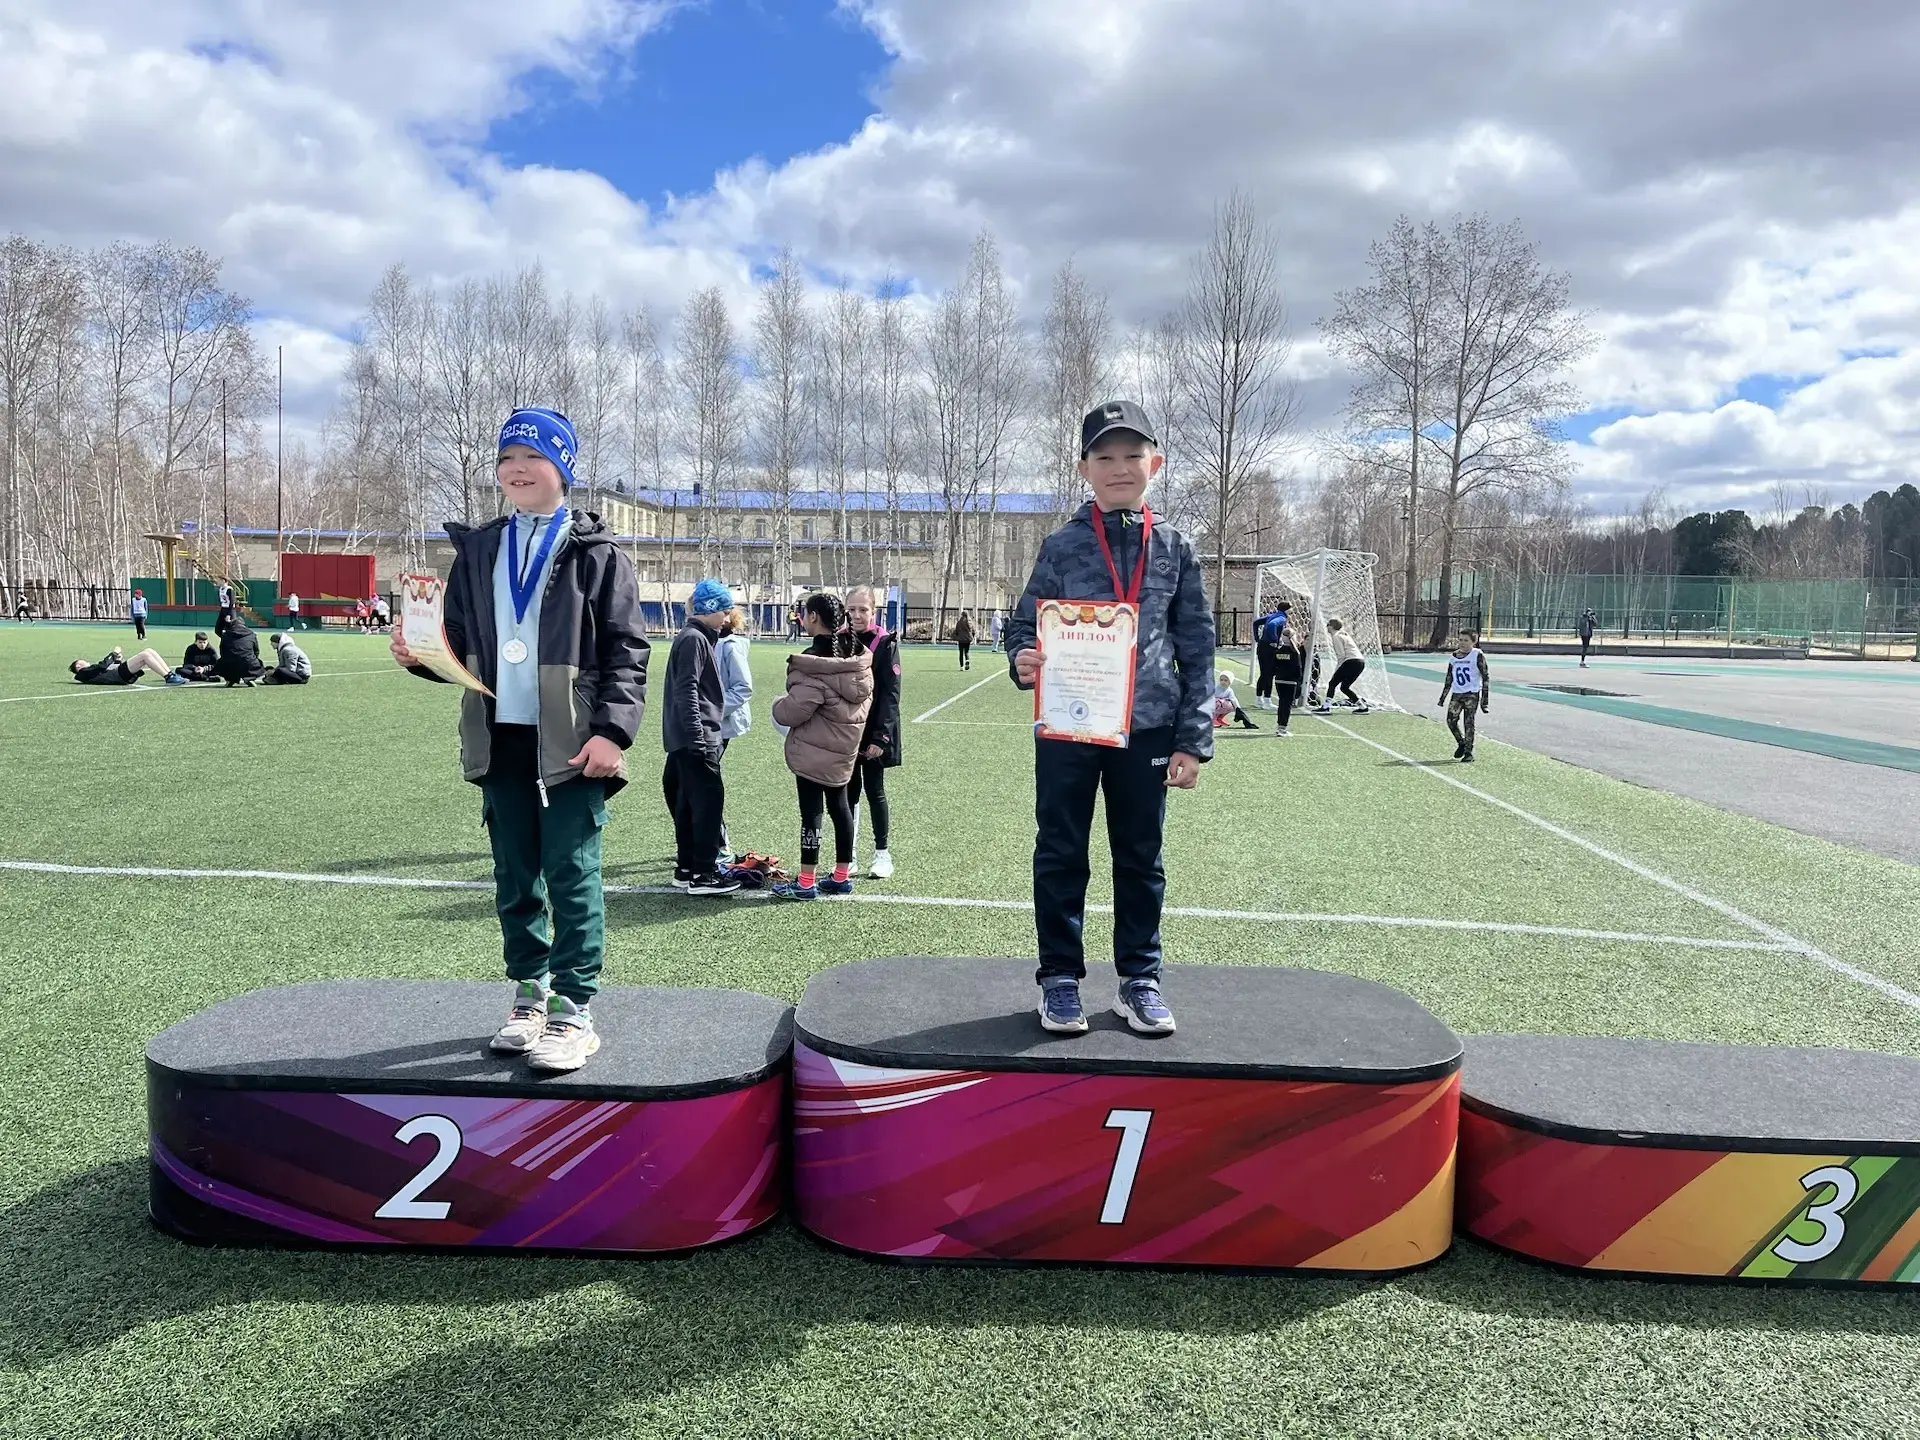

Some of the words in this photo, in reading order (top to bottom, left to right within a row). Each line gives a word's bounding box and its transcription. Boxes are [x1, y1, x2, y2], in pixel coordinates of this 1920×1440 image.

[1057, 631, 1116, 643] ДИПЛОМ
[373, 1113, 463, 1220] 2
[1098, 1108, 1155, 1225] 1
[1770, 1165, 1859, 1263] 3
